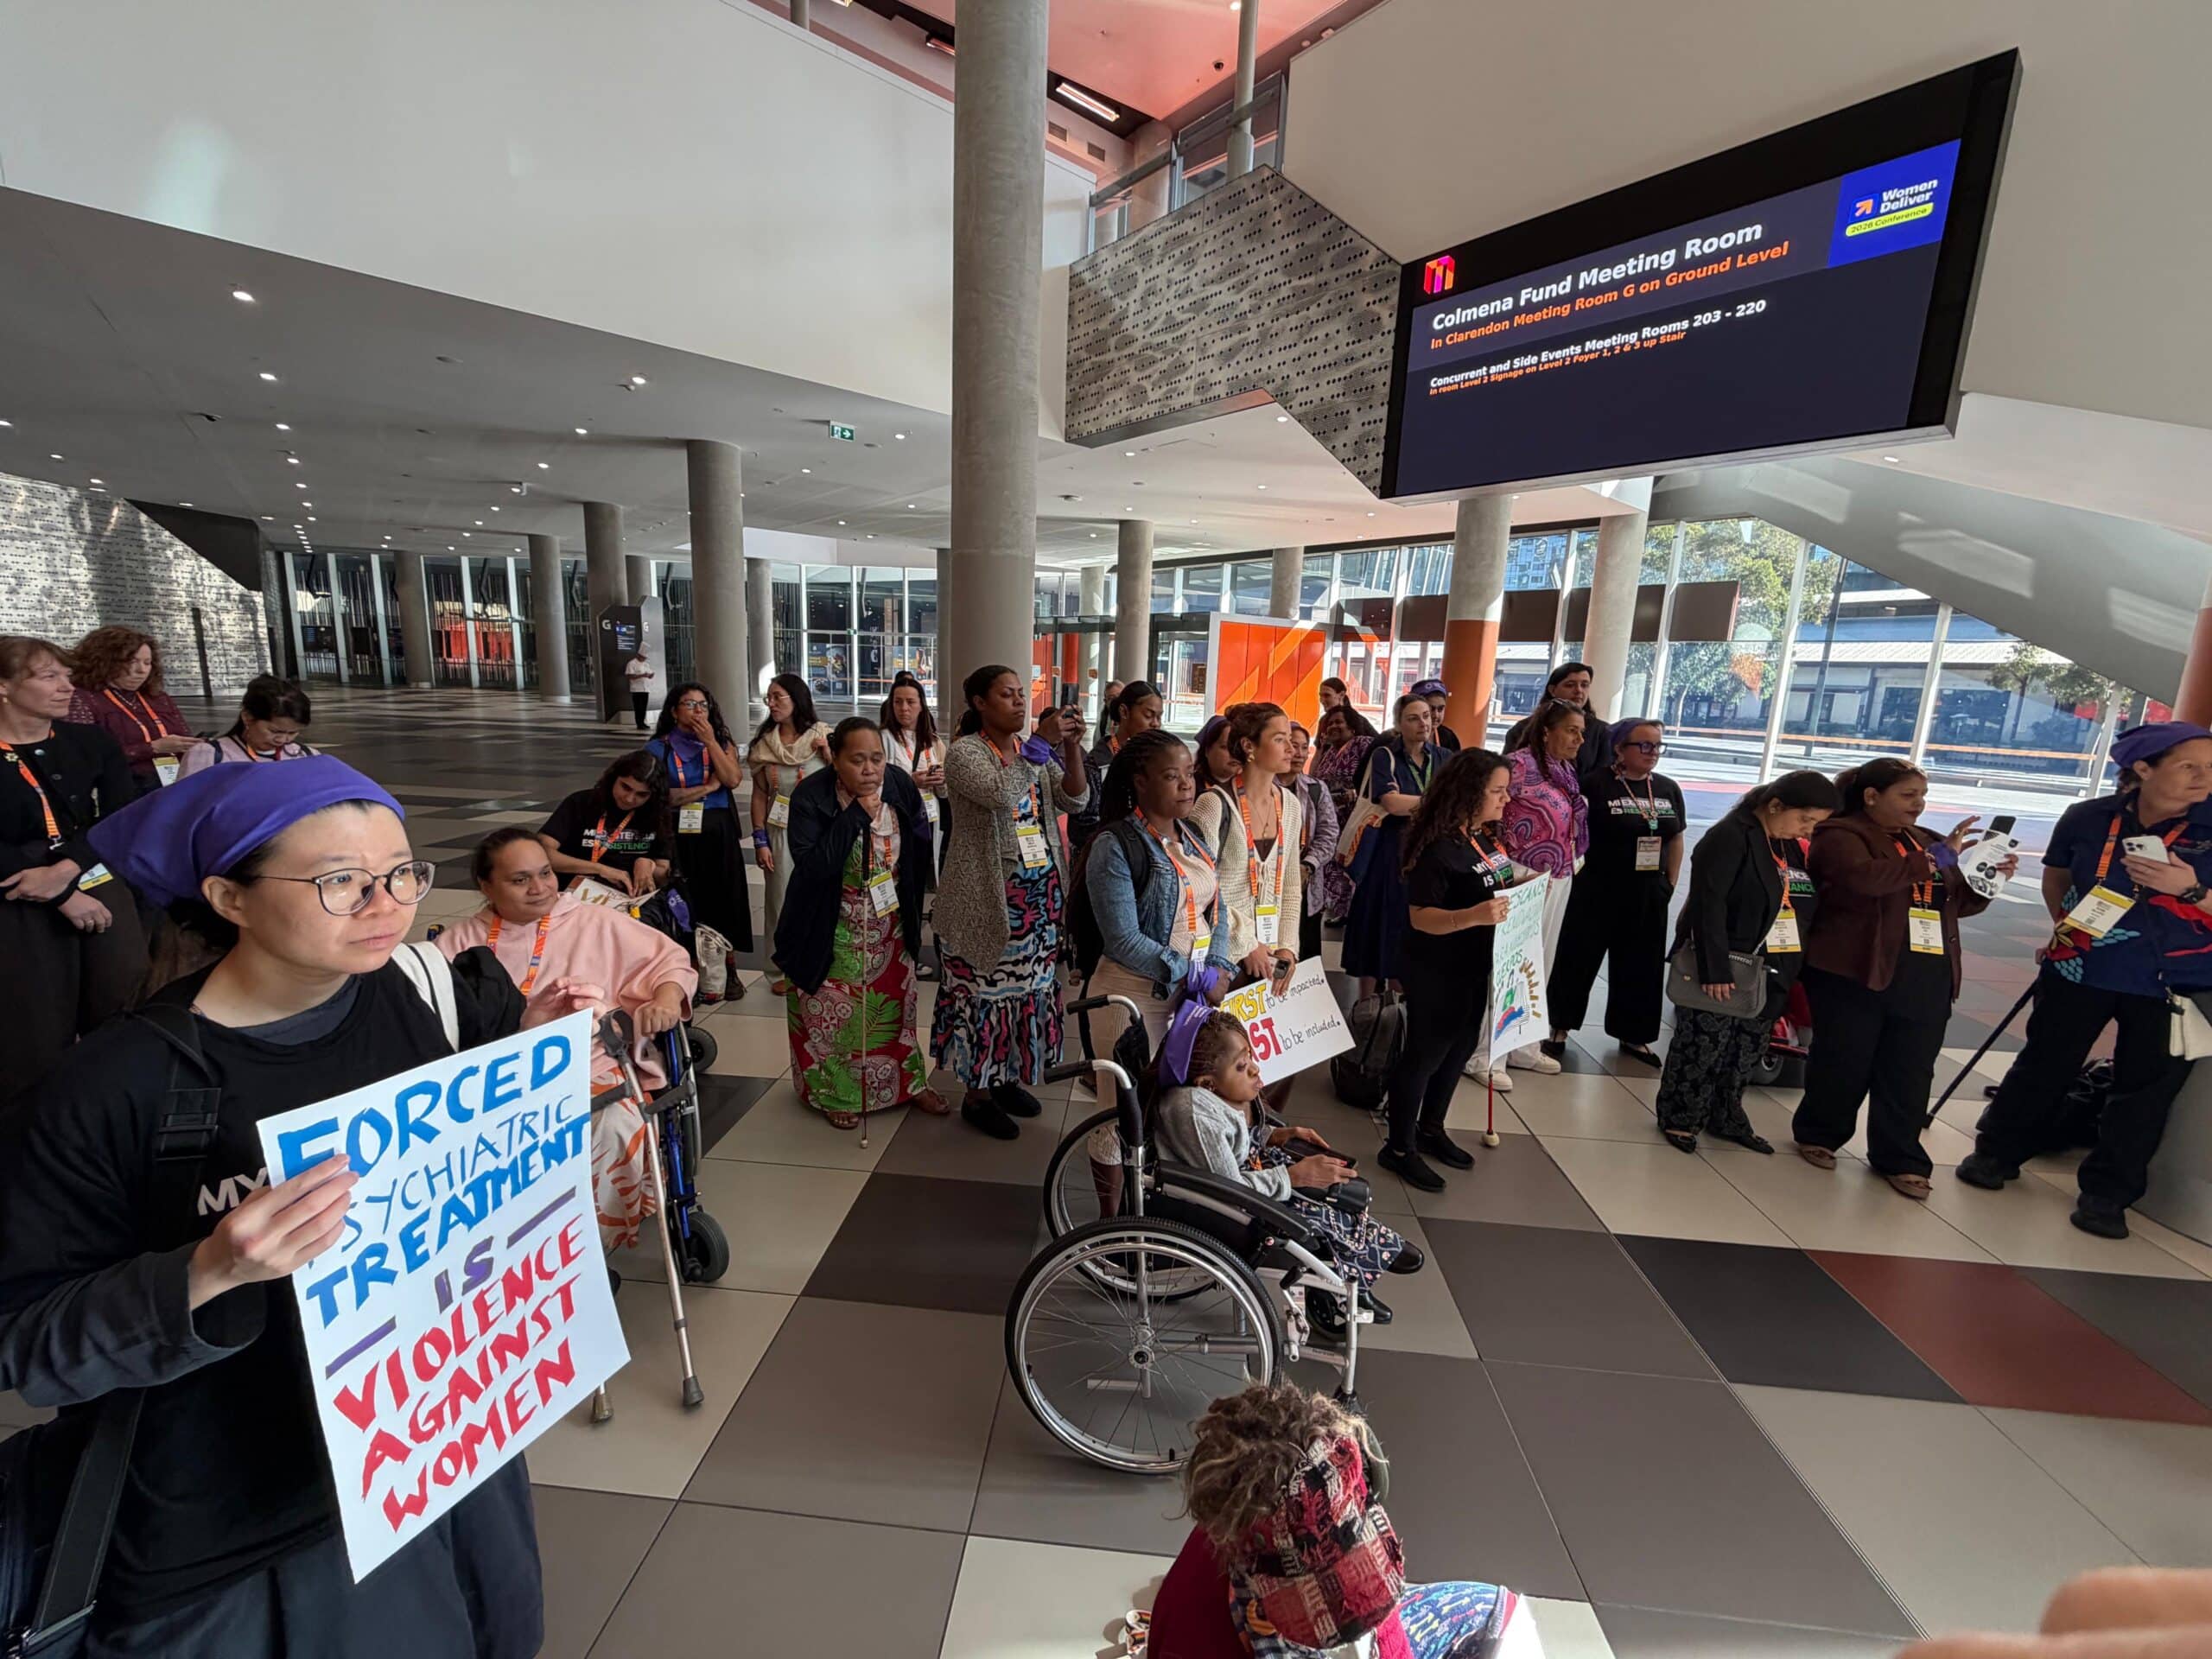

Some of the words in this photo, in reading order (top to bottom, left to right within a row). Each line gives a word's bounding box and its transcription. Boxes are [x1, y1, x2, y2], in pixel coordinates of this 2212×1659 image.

[1850, 221, 1873, 233] 2026
[1874, 207, 1928, 226] Conference
[1880, 191, 1934, 213] Deliver
[1882, 179, 1938, 201] Women
[1431, 338, 1442, 349] In
[1446, 320, 1510, 346] Clarendon
[1514, 303, 1571, 327] Meeting
[1574, 290, 1618, 311] Room
[1623, 284, 1635, 297] G
[1639, 278, 1660, 294] on
[1665, 257, 1732, 287] Ground
[1736, 240, 1789, 269] Level
[1432, 296, 1513, 330] Colmena
[1520, 275, 1572, 307] Fund
[1578, 248, 1676, 289] Meeting
[1684, 224, 1763, 260] Room
[1430, 365, 1487, 388] Concurrent
[1489, 360, 1510, 374] and
[1513, 354, 1538, 369] Side
[1541, 344, 1581, 363] Events
[1585, 331, 1638, 353] Meeting
[1642, 318, 1689, 340] Rooms
[1692, 310, 1722, 327] 203
[1735, 299, 1767, 318] 220
[1439, 384, 1459, 394] room
[1460, 377, 1482, 389] Level
[1490, 369, 1523, 382] Signage
[1525, 365, 1537, 374] on
[1538, 359, 1563, 371] Level
[1565, 357, 1571, 365] 2
[1573, 351, 1600, 364] Foyer
[1613, 345, 1621, 353] 2
[1623, 343, 1631, 352] &
[1634, 340, 1641, 349] 3
[1643, 338, 1657, 349] up
[1659, 331, 1687, 344] Stair
[602, 620, 611, 629] G
[1483, 874, 1494, 887] IS
[1248, 1017, 1282, 1063] ST
[1279, 1033, 1293, 1051] to
[1289, 1028, 1304, 1045] be
[277, 1034, 573, 1181] FORCED
[198, 1167, 269, 1216] MY
[307, 1112, 591, 1329] TREATMENT
[308, 1094, 575, 1269] SYCHIATRIC
[434, 1236, 493, 1313] IS
[333, 1212, 587, 1433] VIOLENCE
[362, 1273, 582, 1503] AGAINST
[382, 1338, 575, 1533] WOMEN
